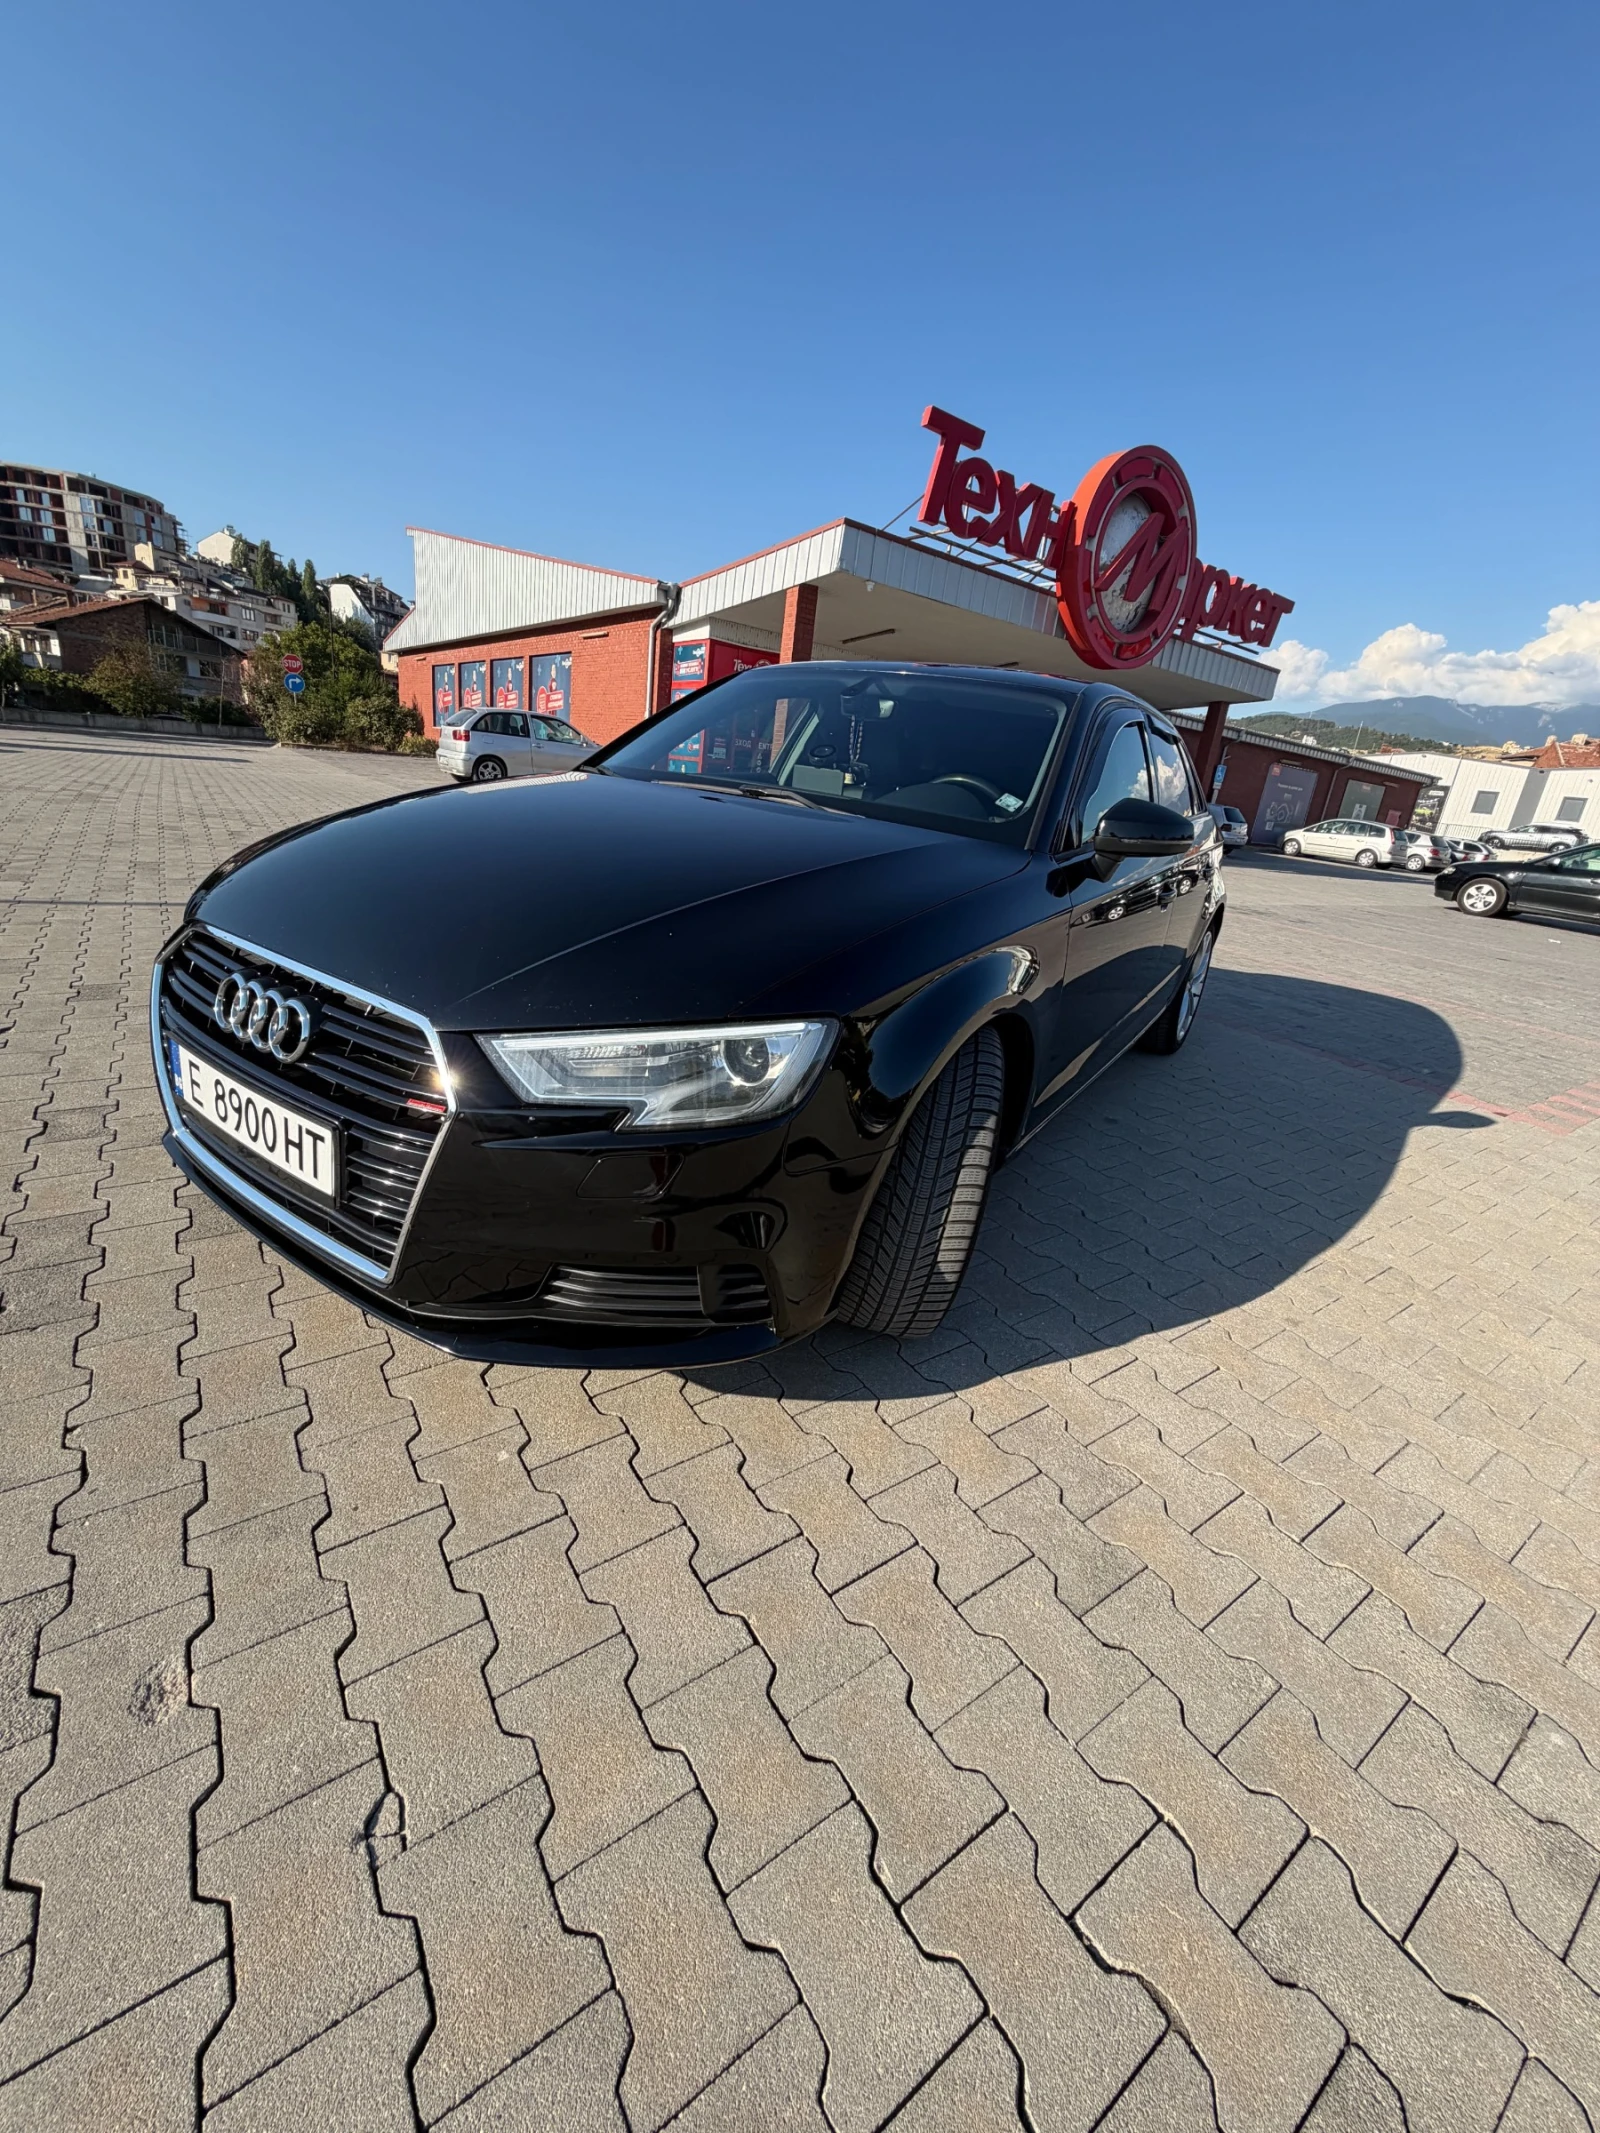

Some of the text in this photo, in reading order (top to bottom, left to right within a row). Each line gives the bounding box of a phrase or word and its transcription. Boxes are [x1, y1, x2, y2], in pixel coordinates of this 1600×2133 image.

[284, 659, 301, 669] STOP
[189, 1059, 325, 1180] E 8900 HT
